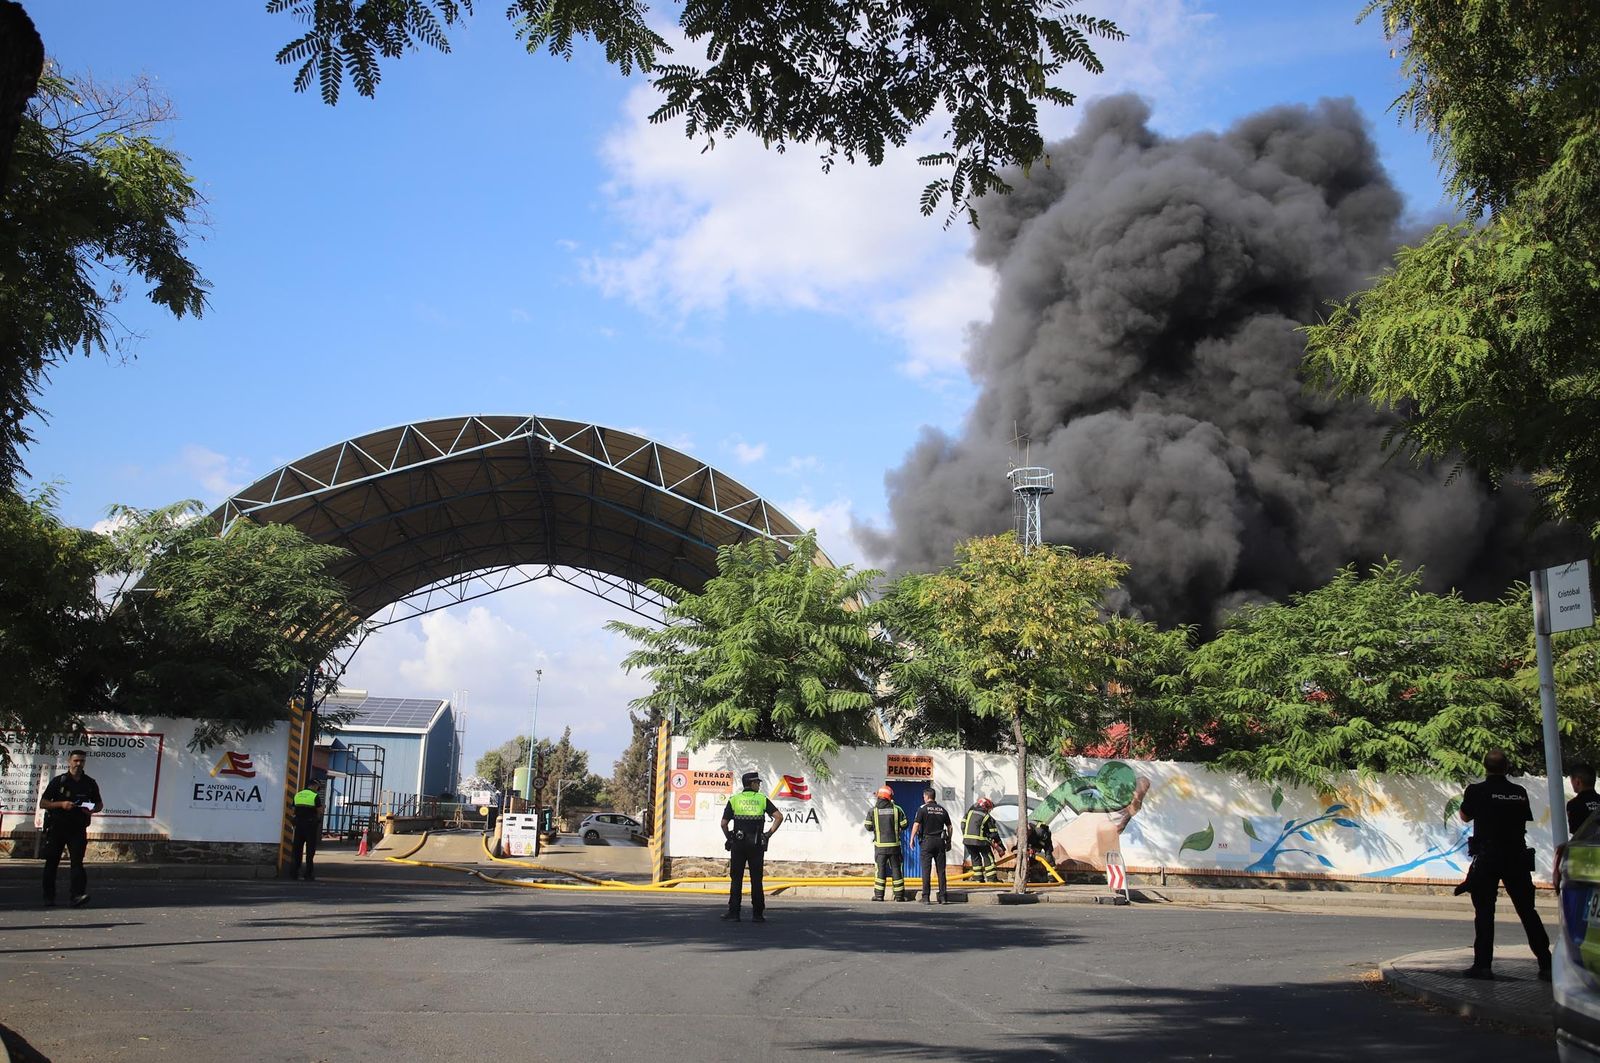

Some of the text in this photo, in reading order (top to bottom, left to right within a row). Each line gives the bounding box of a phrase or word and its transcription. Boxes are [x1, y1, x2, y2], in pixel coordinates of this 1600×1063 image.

[1560, 603, 1580, 613] Dorante
[79, 736, 145, 749] RESIDUOS
[85, 751, 126, 759] ELIGROSOS
[694, 771, 731, 779] ENTRADA
[888, 765, 932, 776] PEATONES
[693, 779, 731, 787] PEATONAL
[193, 783, 263, 802] ESPAÑA
